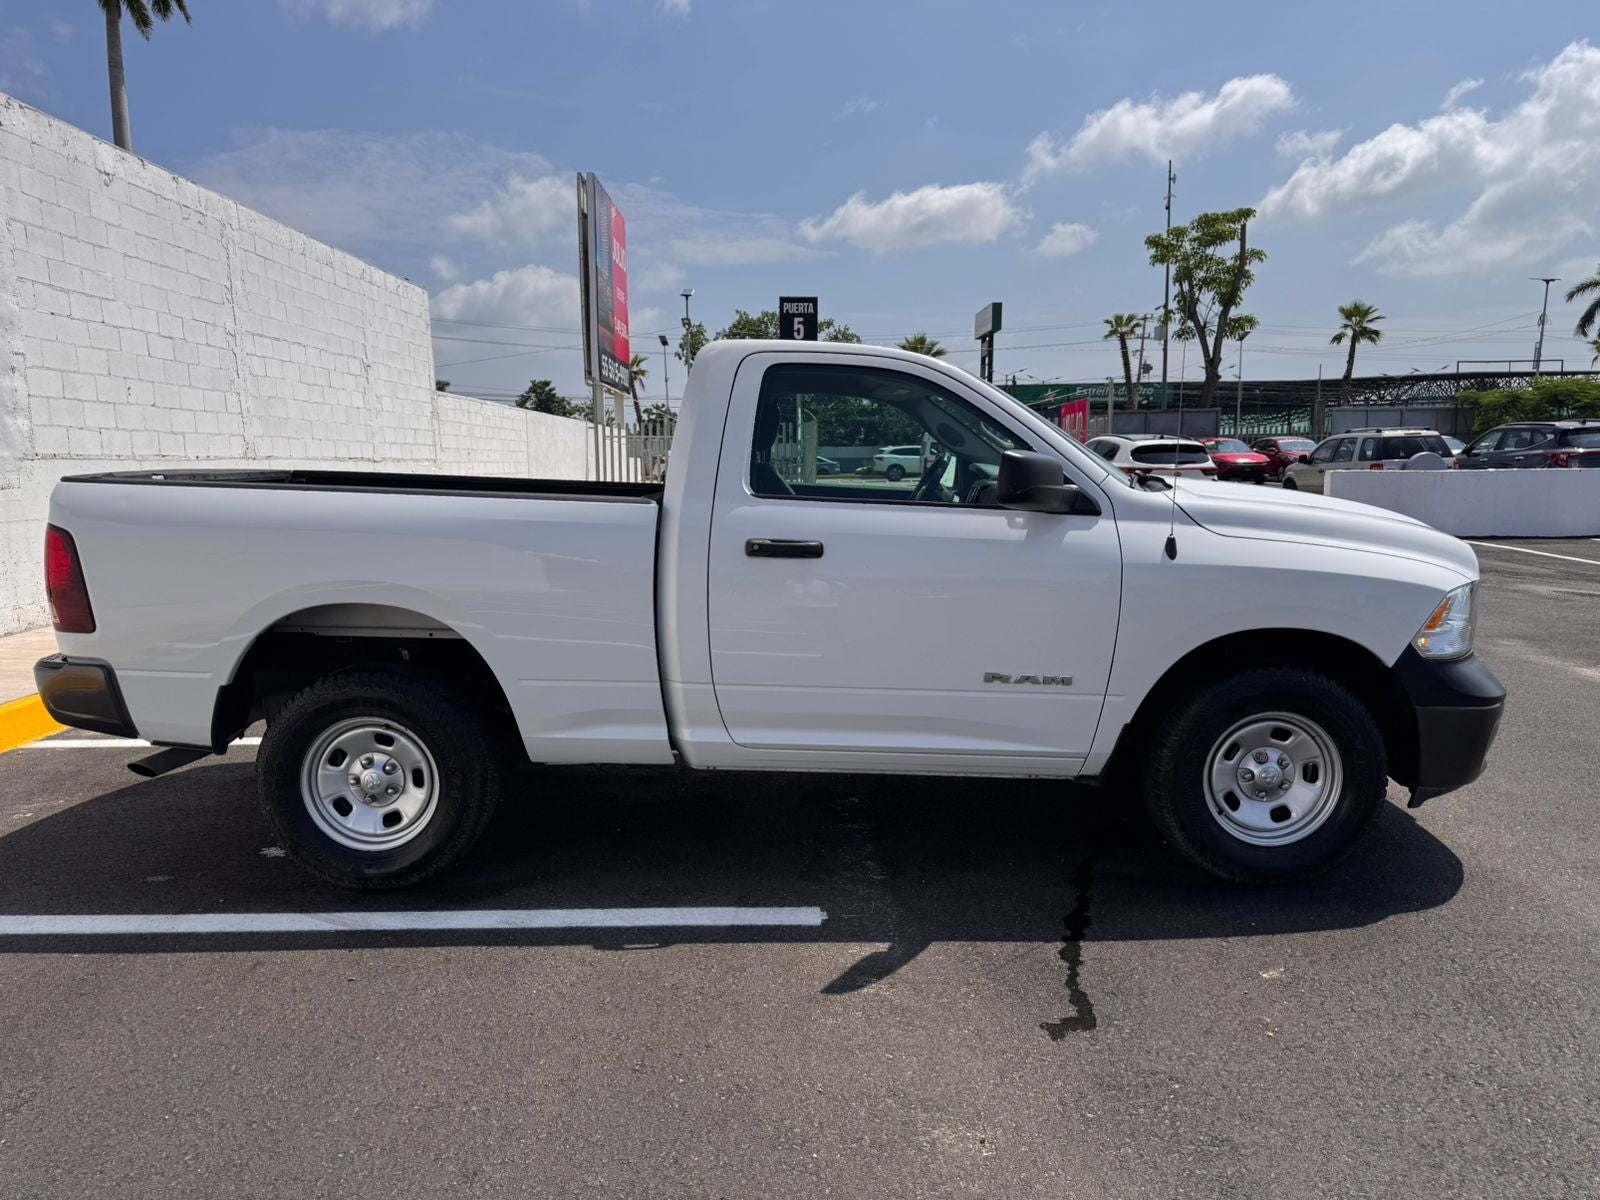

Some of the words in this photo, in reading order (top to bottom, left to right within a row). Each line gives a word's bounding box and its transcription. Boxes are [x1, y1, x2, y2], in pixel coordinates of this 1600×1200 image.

[783, 302, 814, 314] PUERTA
[793, 317, 805, 340] 5
[1076, 386, 1114, 396] Estrell
[983, 672, 1073, 686] RAM
